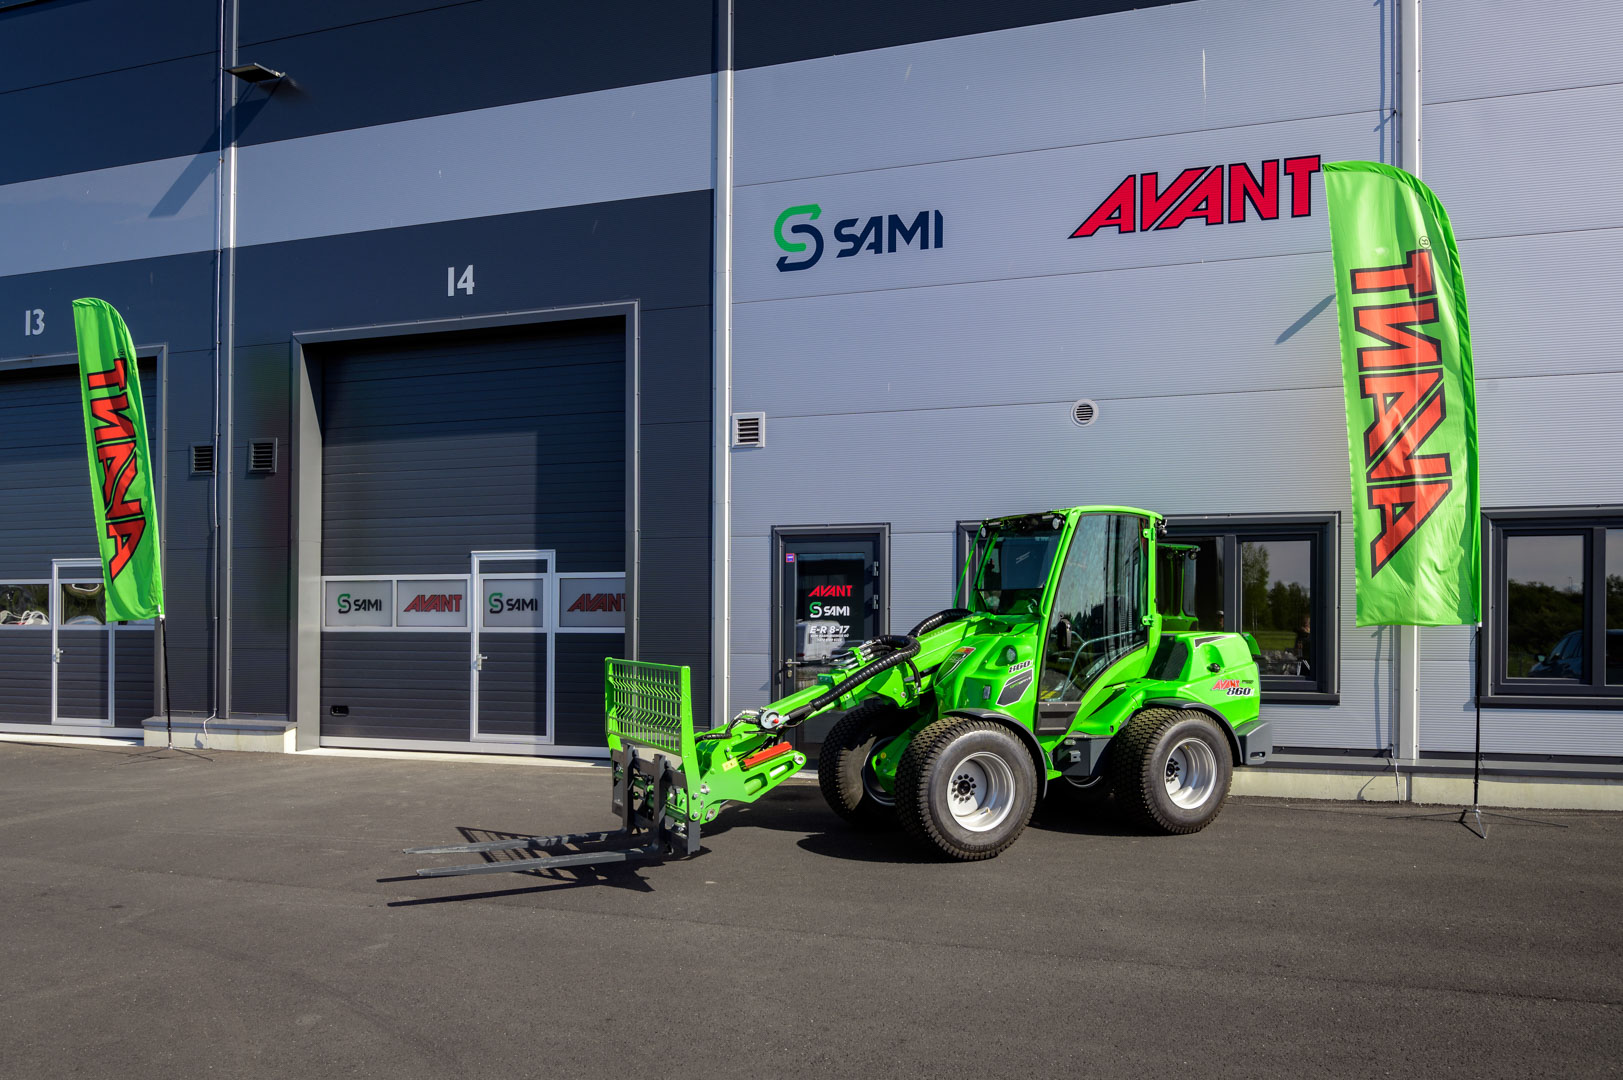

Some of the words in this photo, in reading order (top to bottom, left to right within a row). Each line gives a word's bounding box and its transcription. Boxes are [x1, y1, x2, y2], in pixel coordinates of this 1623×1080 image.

[1069, 155, 1321, 239] AVANT
[834, 209, 944, 259] SAMI
[447, 264, 475, 297] 14
[24, 308, 46, 337] 13
[808, 585, 852, 597] AVANT
[353, 599, 382, 612] SAMI
[403, 594, 463, 612] AVANT
[506, 598, 538, 612] SAMI
[824, 605, 850, 617] SAMI
[809, 625, 828, 634] E-R
[829, 625, 850, 634] 8-17
[1212, 679, 1240, 690] AVANT
